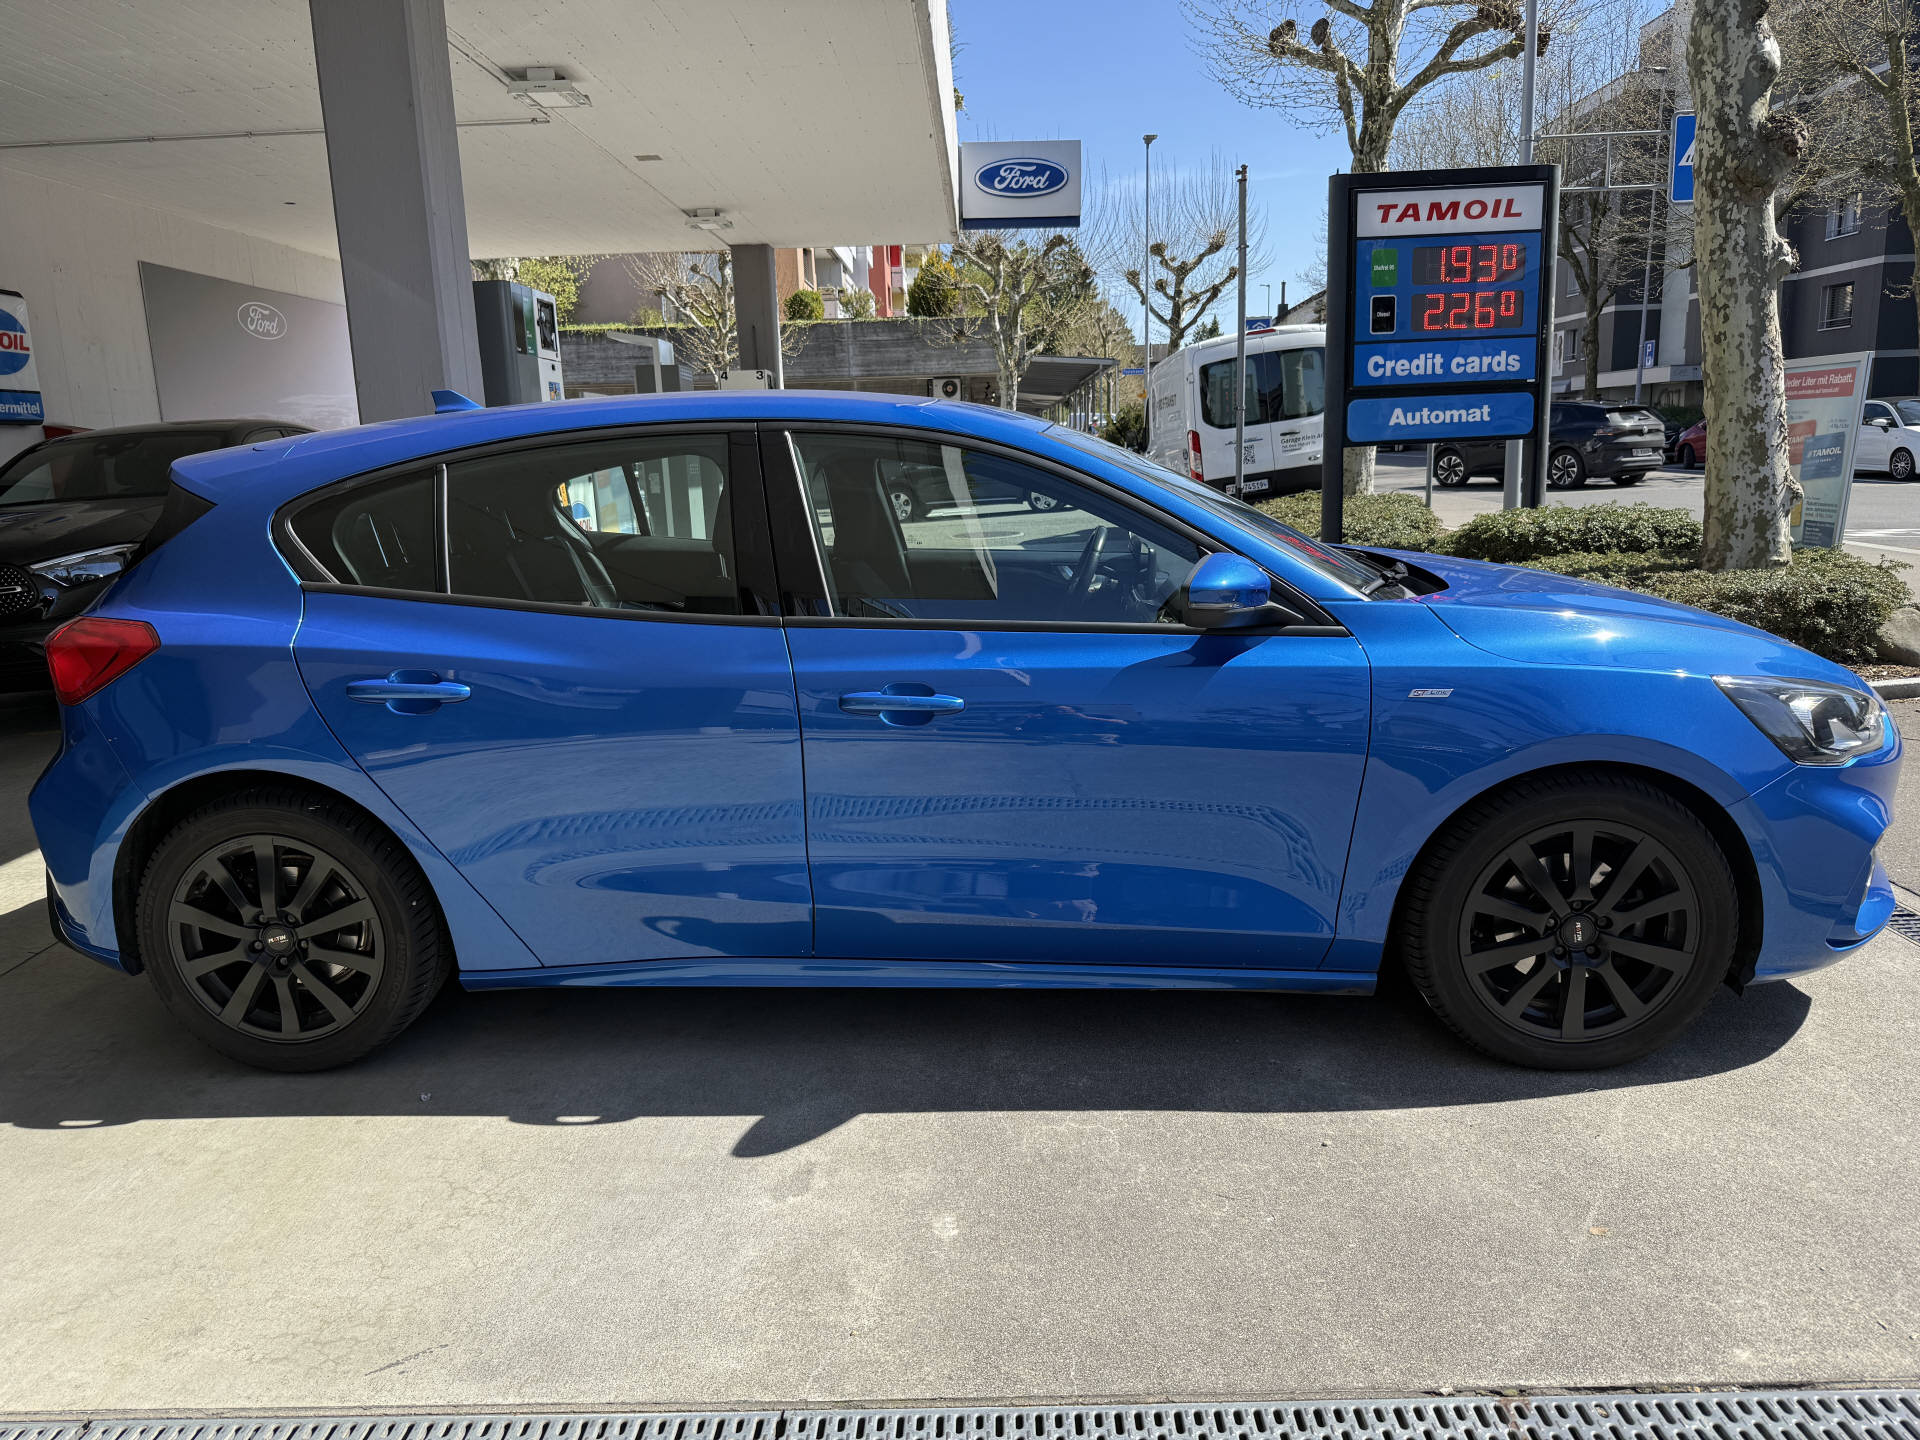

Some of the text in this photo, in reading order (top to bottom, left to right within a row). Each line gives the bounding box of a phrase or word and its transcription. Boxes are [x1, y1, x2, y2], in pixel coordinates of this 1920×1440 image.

[994, 165, 1050, 189] Ford
[1377, 198, 1522, 224] TAMOIL
[247, 305, 280, 335] Ford
[1367, 350, 1521, 378] Credit cards
[720, 370, 764, 381] 4 3
[1802, 376, 1817, 387] Liter
[1817, 375, 1829, 385] mit
[1388, 405, 1490, 426] Automat
[1280, 436, 1301, 445] Garage
[1812, 446, 1842, 457] TAMOIL
